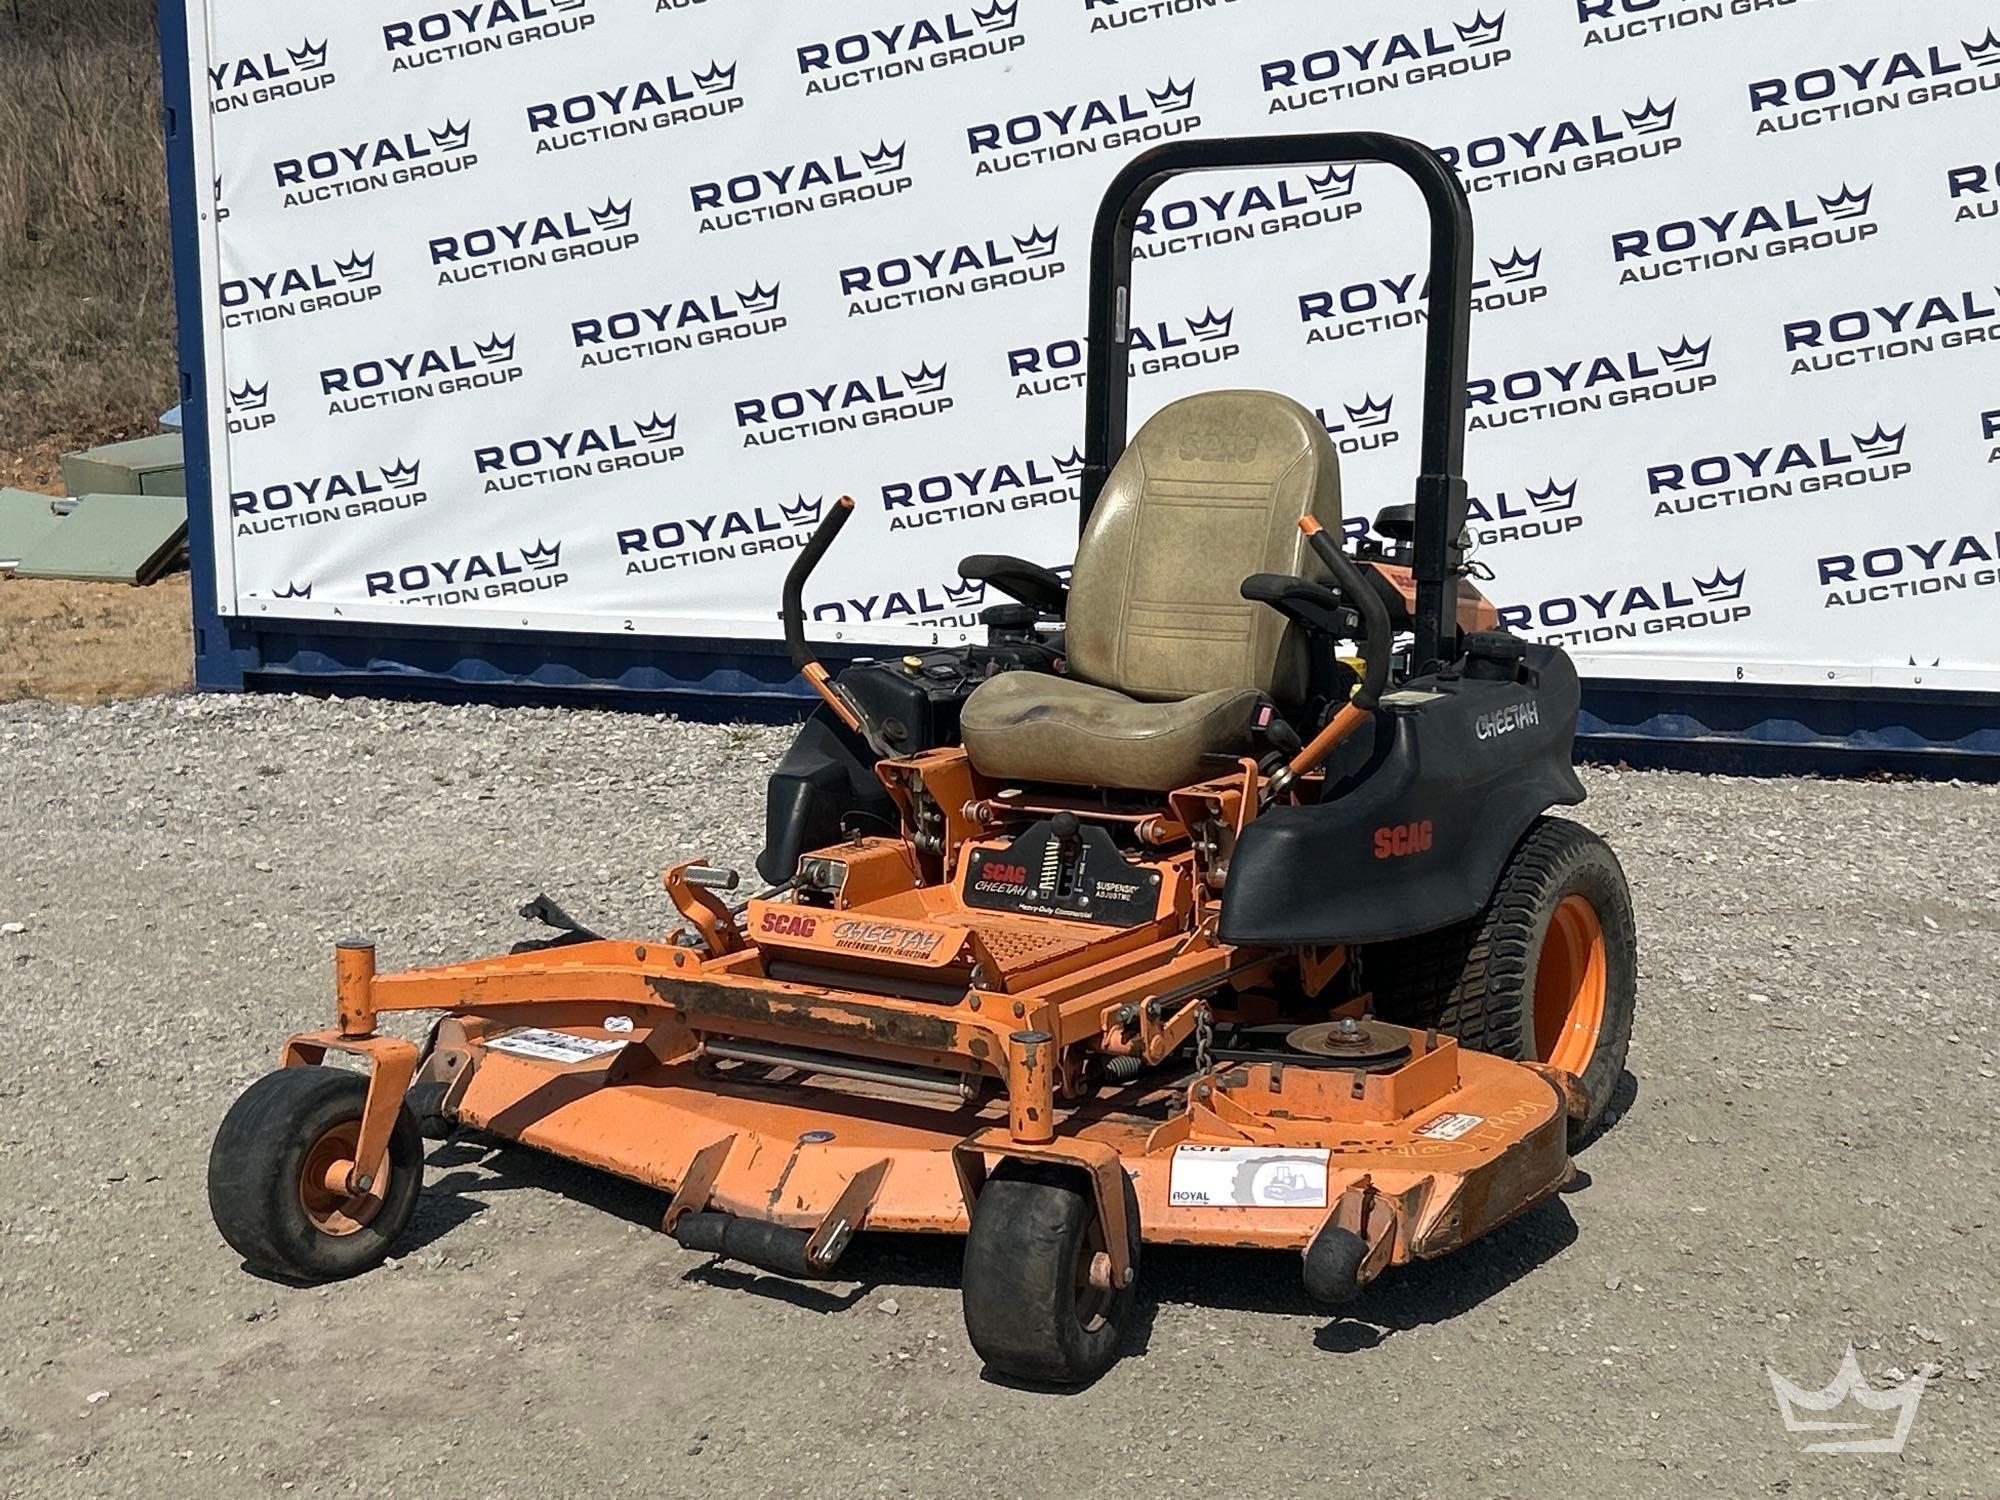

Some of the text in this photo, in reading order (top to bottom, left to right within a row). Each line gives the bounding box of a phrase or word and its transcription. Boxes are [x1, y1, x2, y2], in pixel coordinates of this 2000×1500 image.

[383, 0, 547, 51] ROYAL
[393, 14, 595, 72] AUCTION GROUP
[797, 13, 974, 74] ROYAL
[1584, 3, 1723, 47] AUCTION
[806, 35, 1025, 96] AUCTION GROUP
[1260, 28, 1455, 92] ROYAL
[1268, 49, 1511, 115] AUCTION GROUP
[1749, 46, 1961, 112] ROYAL
[253, 73, 335, 103] GROUP
[527, 76, 694, 132] ROYAL
[536, 97, 744, 154] AUCTION GROUP
[967, 94, 1148, 154] ROYAL
[1756, 93, 1899, 136] AUCTION
[274, 133, 431, 187] ROYAL
[976, 116, 1201, 177] AUCTION GROUP
[1573, 137, 1681, 172] GROUP
[284, 154, 478, 208] AUCTION GROUP
[690, 156, 862, 212] ROYAL
[699, 177, 912, 233] AUCTION GROUP
[429, 212, 591, 265] ROYAL
[1132, 202, 1362, 260] AUCTION GROUP
[1612, 200, 1818, 262] ROYAL
[1619, 223, 1878, 285] AUCTION GROUP
[438, 233, 639, 286] AUCTION GROUP
[839, 240, 1014, 296] ROYAL
[223, 285, 381, 329] CTION GROUP
[848, 262, 1065, 317] AUCTION GROUP
[571, 295, 738, 347] ROYAL
[581, 317, 787, 368] AUCTION GROUP
[1783, 291, 1995, 352] ROYAL
[320, 346, 476, 395] ROYAL
[1142, 344, 1239, 374] GROUP
[1466, 352, 1659, 409] ROYAL
[1791, 336, 1933, 375] AUCTION
[329, 367, 523, 415] AUCTION GROUP
[734, 376, 904, 427] ROYAL
[1468, 374, 1716, 432] AUCTION GROUP
[744, 397, 953, 448] AUCTION GROUP
[474, 425, 637, 474] ROYAL
[484, 446, 684, 494] AUCTION GROUP
[1647, 438, 1852, 495] ROYAL
[231, 471, 383, 517] ROYAL
[881, 460, 1054, 511] ROYAL
[1654, 463, 1911, 517] AUCTION GROUP
[238, 492, 427, 537] AUCTION GROUP
[617, 507, 781, 555] ROYAL
[890, 499, 1005, 531] AUCTION
[1477, 516, 1583, 549] GROUP
[366, 552, 522, 597] ROYAL
[484, 573, 568, 598] GROUP
[626, 545, 736, 576] AUCTION
[1497, 582, 1693, 632] ROYAL
[1825, 573, 1966, 608] AUCTION
[1644, 606, 1751, 634] GROUP
[1476, 701, 1539, 740] CHEETAH
[1375, 820, 1433, 859] SCAG
[975, 880, 1029, 898] CHEETAH
[982, 863, 1027, 883] SCAG
[761, 912, 816, 938] SCAG
[833, 920, 945, 951] CHEETAH
[1019, 903, 1093, 918] Heavy-Duty Commercial
[1172, 1191, 1210, 1201] ROYAL
